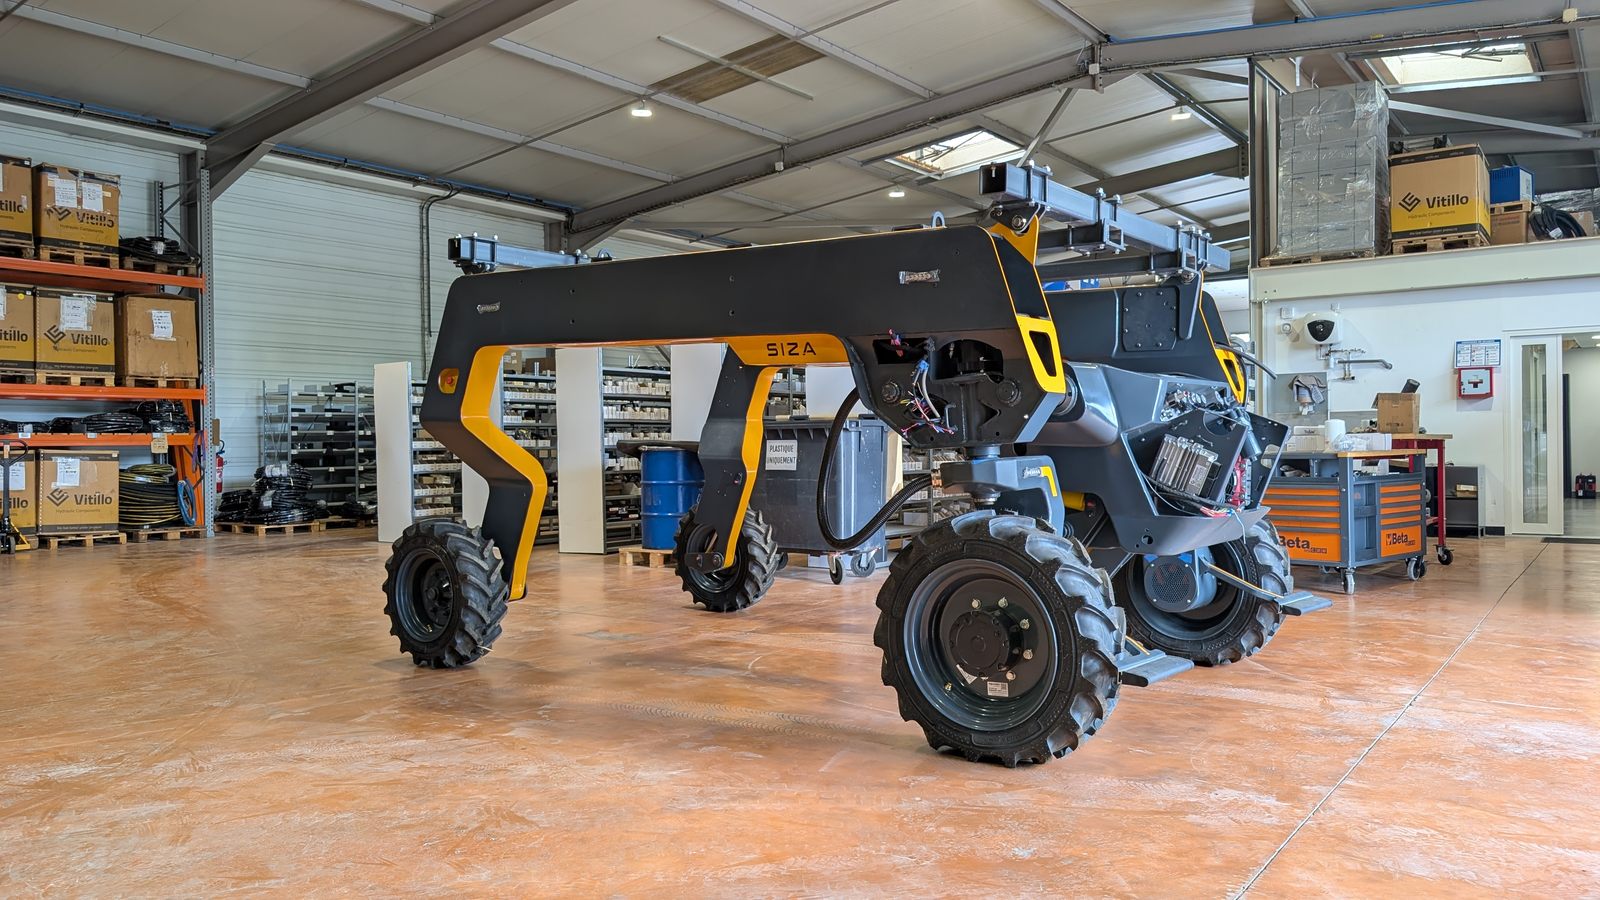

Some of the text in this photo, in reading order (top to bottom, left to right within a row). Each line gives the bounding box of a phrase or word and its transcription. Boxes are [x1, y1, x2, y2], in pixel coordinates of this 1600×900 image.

[0, 199, 25, 214] tillo
[1426, 194, 1469, 209] Vitillo
[76, 211, 114, 228] Vitillo
[0, 329, 28, 342] itillo
[71, 333, 108, 346] Vitillo
[767, 341, 816, 356] SIZA
[769, 444, 794, 453] PLASTIQUE
[74, 493, 112, 505] Vitillo
[1279, 535, 1310, 549] Beta
[1392, 532, 1408, 545] Beta
